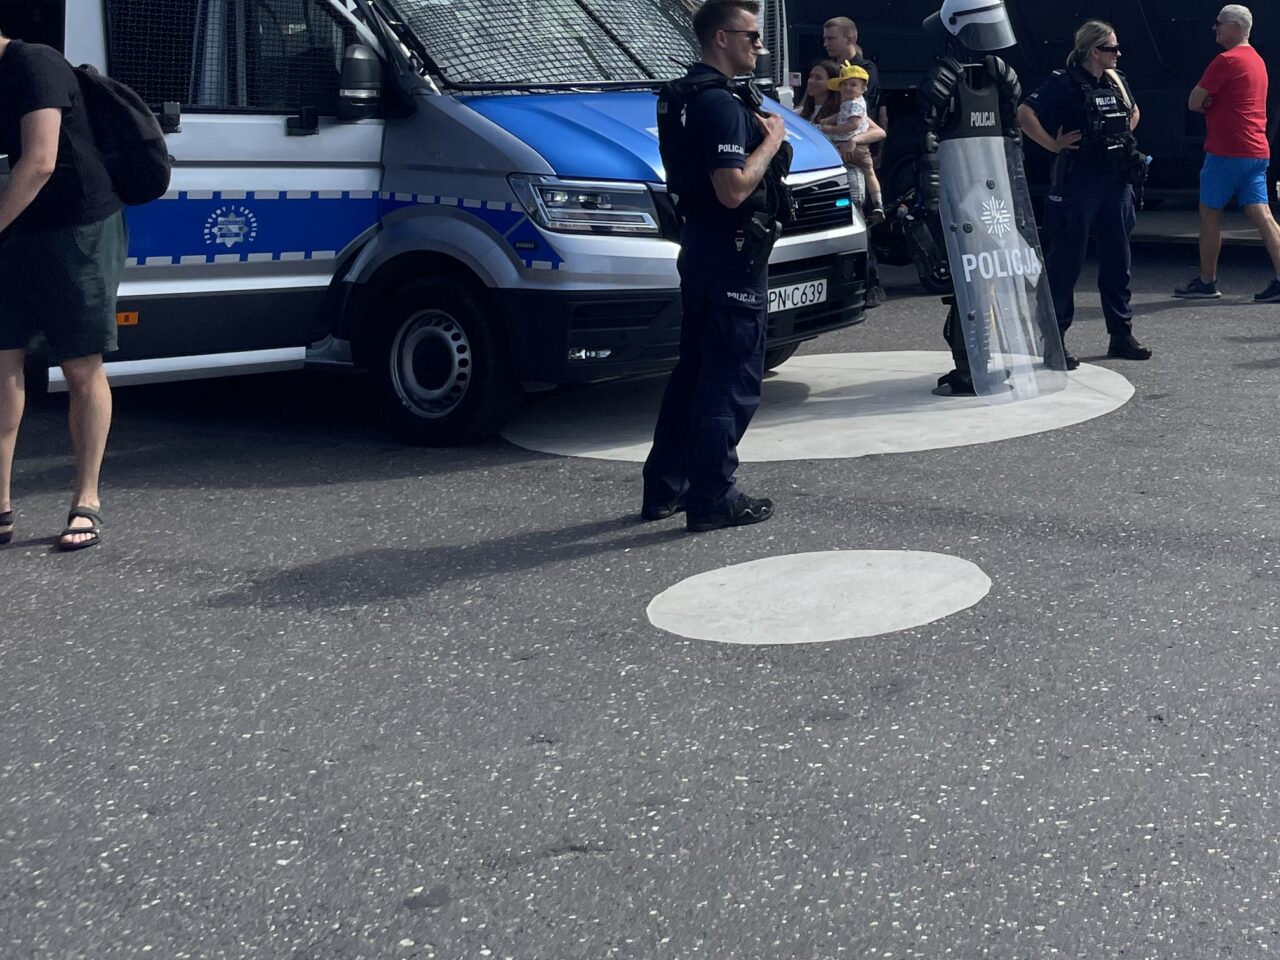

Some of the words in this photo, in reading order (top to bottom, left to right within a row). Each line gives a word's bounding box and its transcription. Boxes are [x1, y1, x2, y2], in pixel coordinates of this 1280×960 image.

[1095, 96, 1117, 106] POLICJA
[970, 111, 996, 127] POLICJA
[961, 247, 1042, 283] POLICJA
[791, 282, 824, 307] C639
